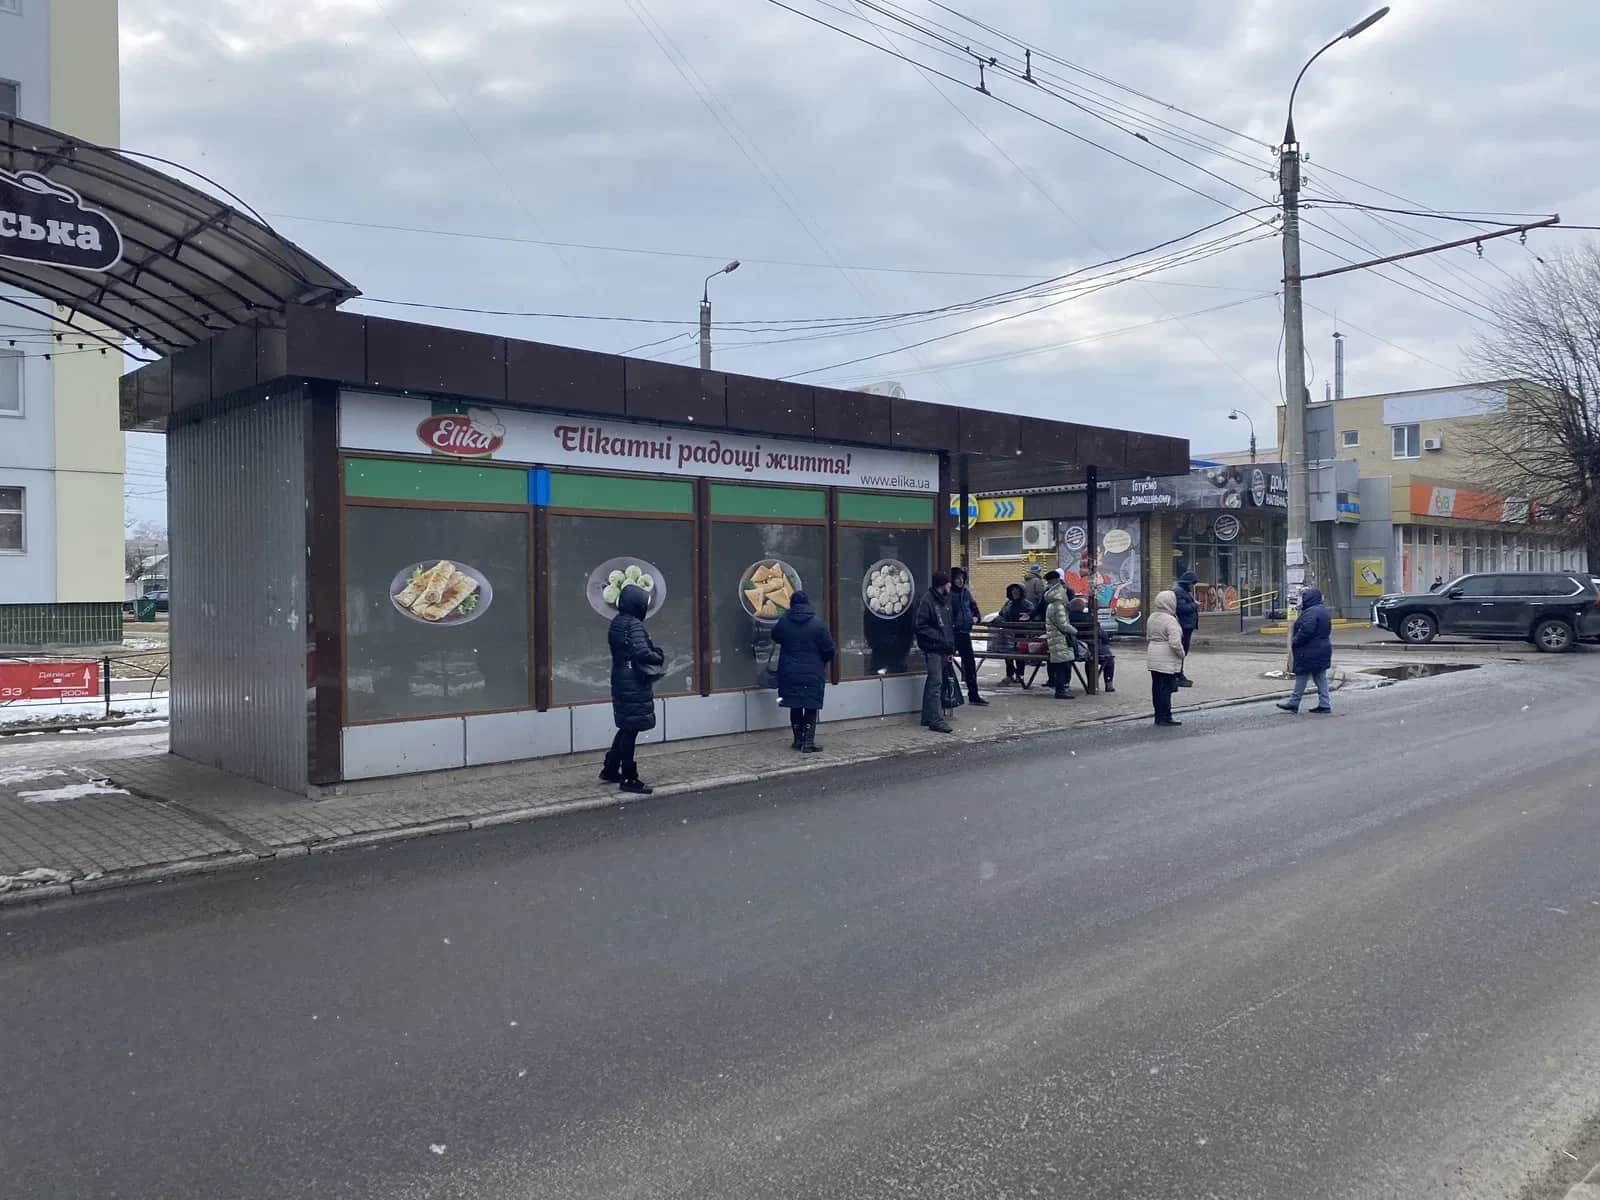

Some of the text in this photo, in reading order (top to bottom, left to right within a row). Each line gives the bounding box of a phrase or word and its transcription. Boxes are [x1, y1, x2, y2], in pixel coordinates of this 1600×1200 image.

[0, 210, 102, 251] ська
[432, 419, 490, 449] Elika
[678, 440, 761, 472] радощі
[766, 451, 852, 475] життя!
[860, 474, 930, 490] www.elika.ua
